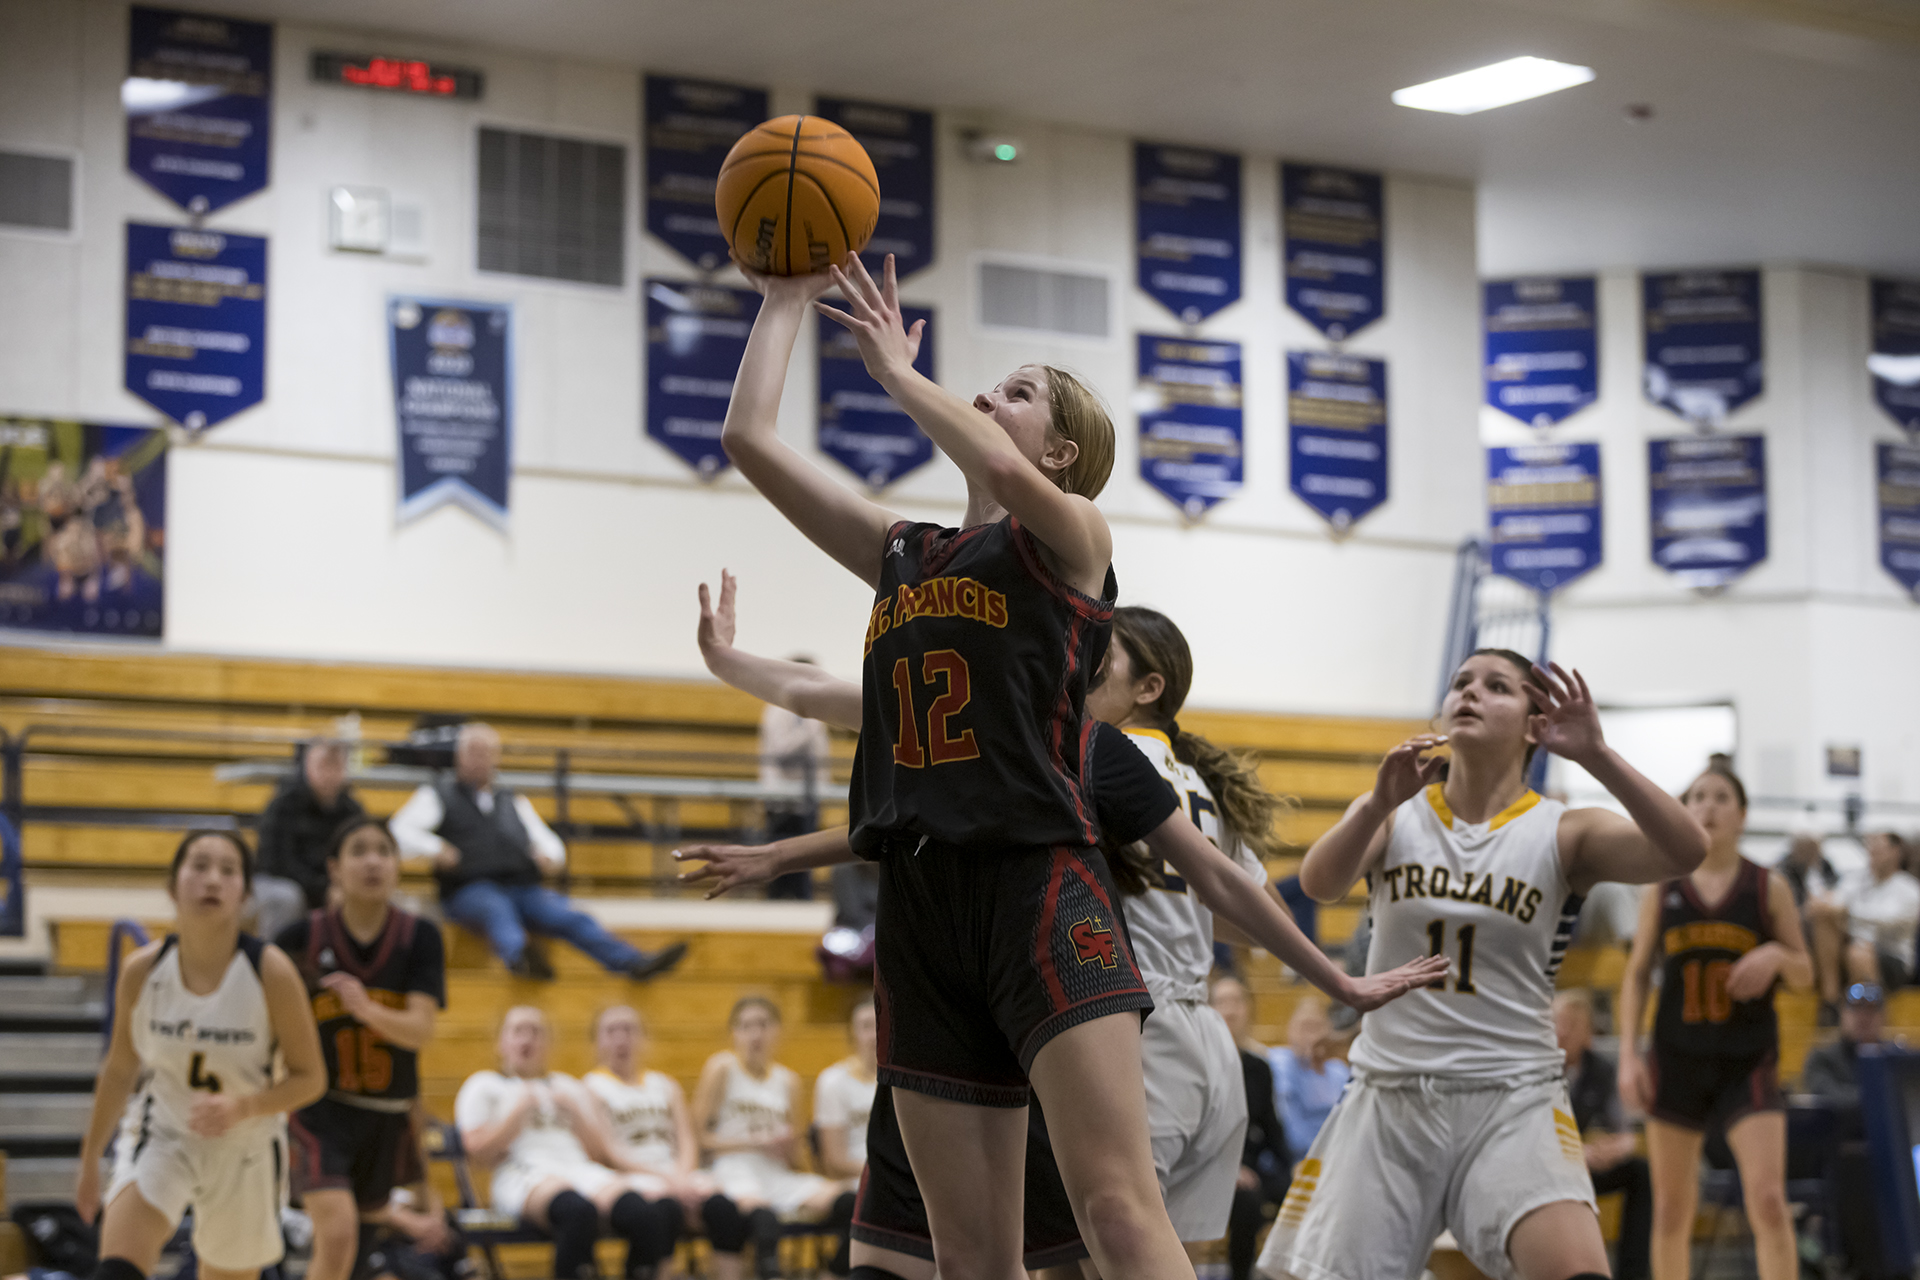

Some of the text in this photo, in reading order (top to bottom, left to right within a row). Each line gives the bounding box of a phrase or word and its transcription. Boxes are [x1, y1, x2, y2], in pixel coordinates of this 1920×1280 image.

[892, 648, 981, 769] 12
[1383, 863, 1543, 924] TROJANS
[1068, 916, 1118, 969] SF
[1426, 918, 1477, 995] 11
